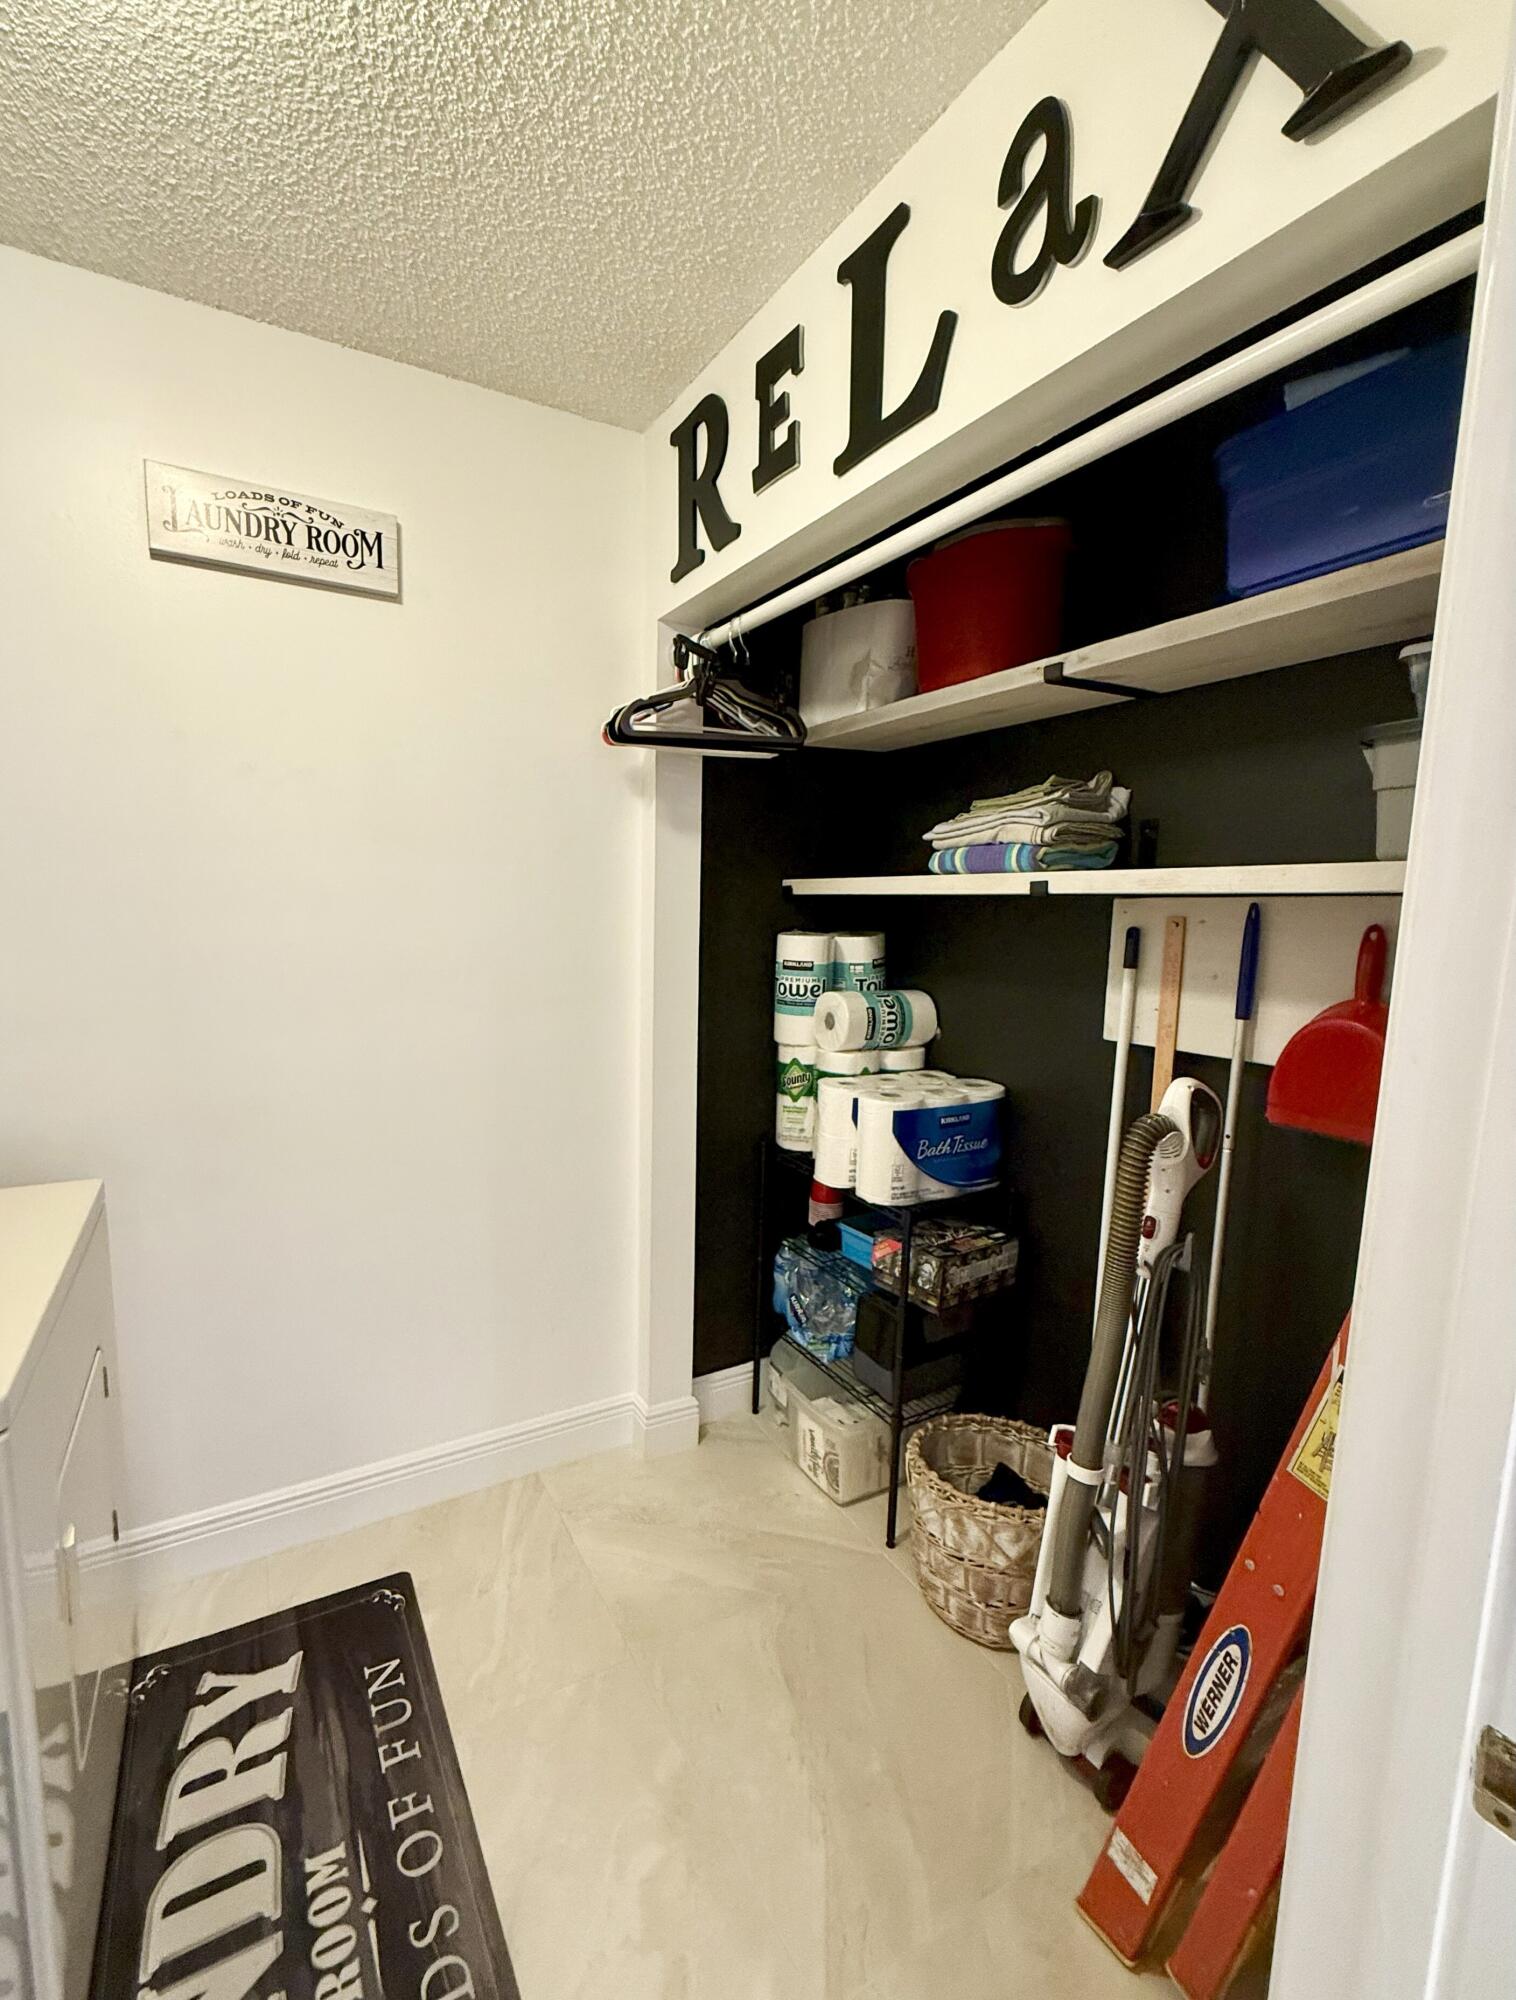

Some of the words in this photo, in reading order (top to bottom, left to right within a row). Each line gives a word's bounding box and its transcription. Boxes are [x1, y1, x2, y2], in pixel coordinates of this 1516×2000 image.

[162, 485, 298, 547] LAUNDRY
[306, 523, 385, 571] ROOM
[212, 490, 275, 502] LOADS
[278, 496, 302, 510] OF
[305, 504, 345, 530] FUN
[218, 536, 246, 551] wash
[254, 543, 273, 559] dry
[281, 548, 301, 561] fold
[309, 555, 339, 569] repeat
[776, 978, 826, 998] owel
[875, 994, 898, 1046] owel
[916, 1138, 951, 1160] Bath
[952, 1134, 988, 1156] Tissue
[363, 1657, 421, 1774] FUN
[1194, 1651, 1239, 1736] WERNER
[387, 1791, 443, 1878] OF
[305, 1841, 363, 2000] ROOM
